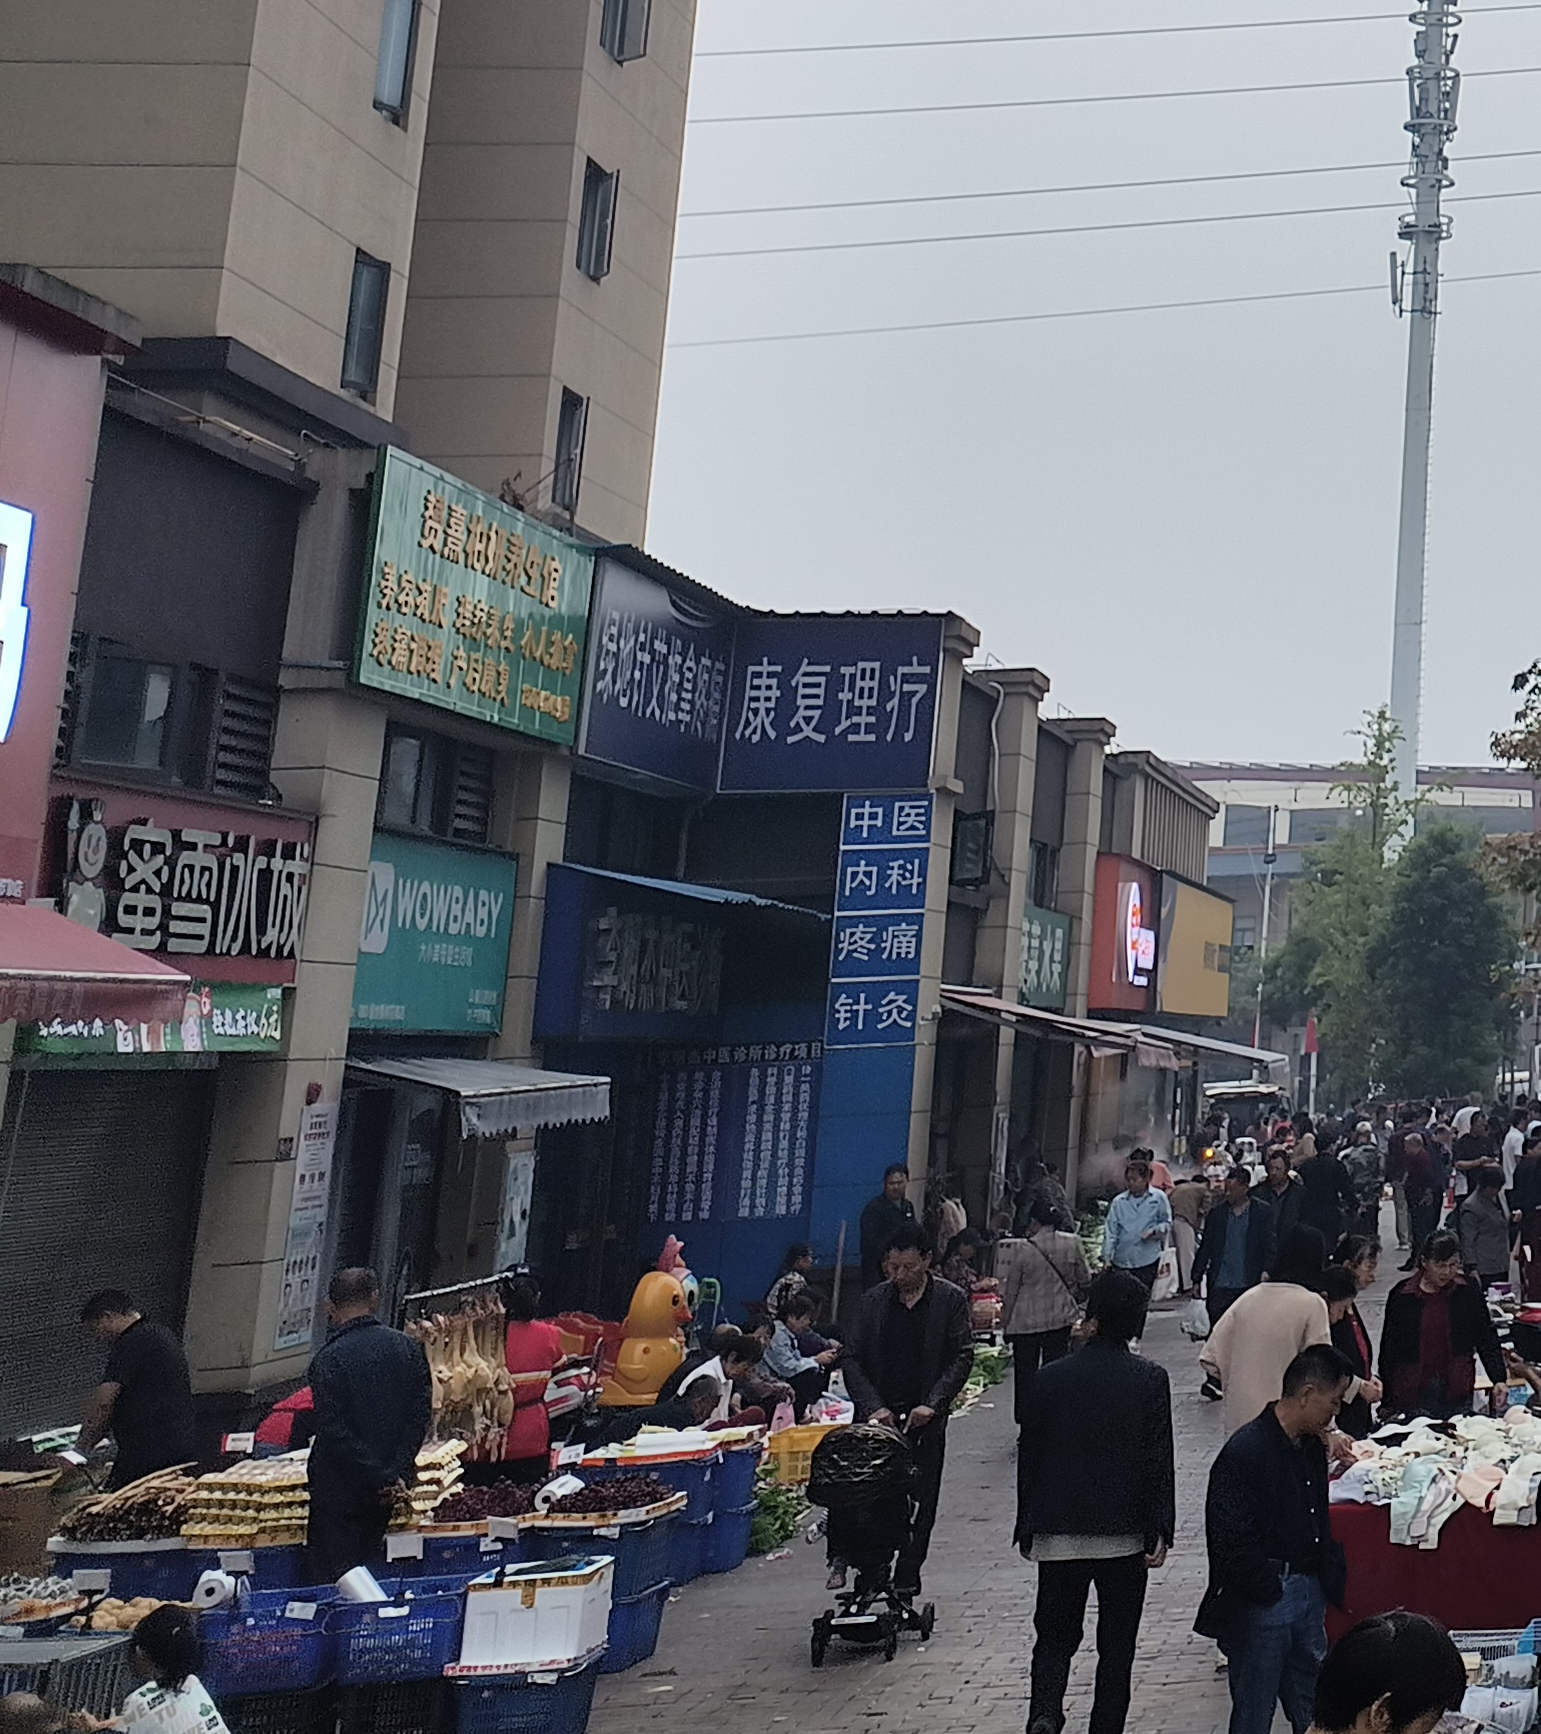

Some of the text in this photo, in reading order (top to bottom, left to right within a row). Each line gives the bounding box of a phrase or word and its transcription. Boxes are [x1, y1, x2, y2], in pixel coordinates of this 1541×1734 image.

[735, 655, 932, 745] 康复理疗
[849, 800, 930, 839] 中医
[110, 817, 310, 958] 蜜雪冰城
[845, 858, 924, 897] 内科
[397, 878, 503, 938] WOWBABY
[837, 924, 919, 961] 疼痛
[834, 992, 914, 1031] 针灸
